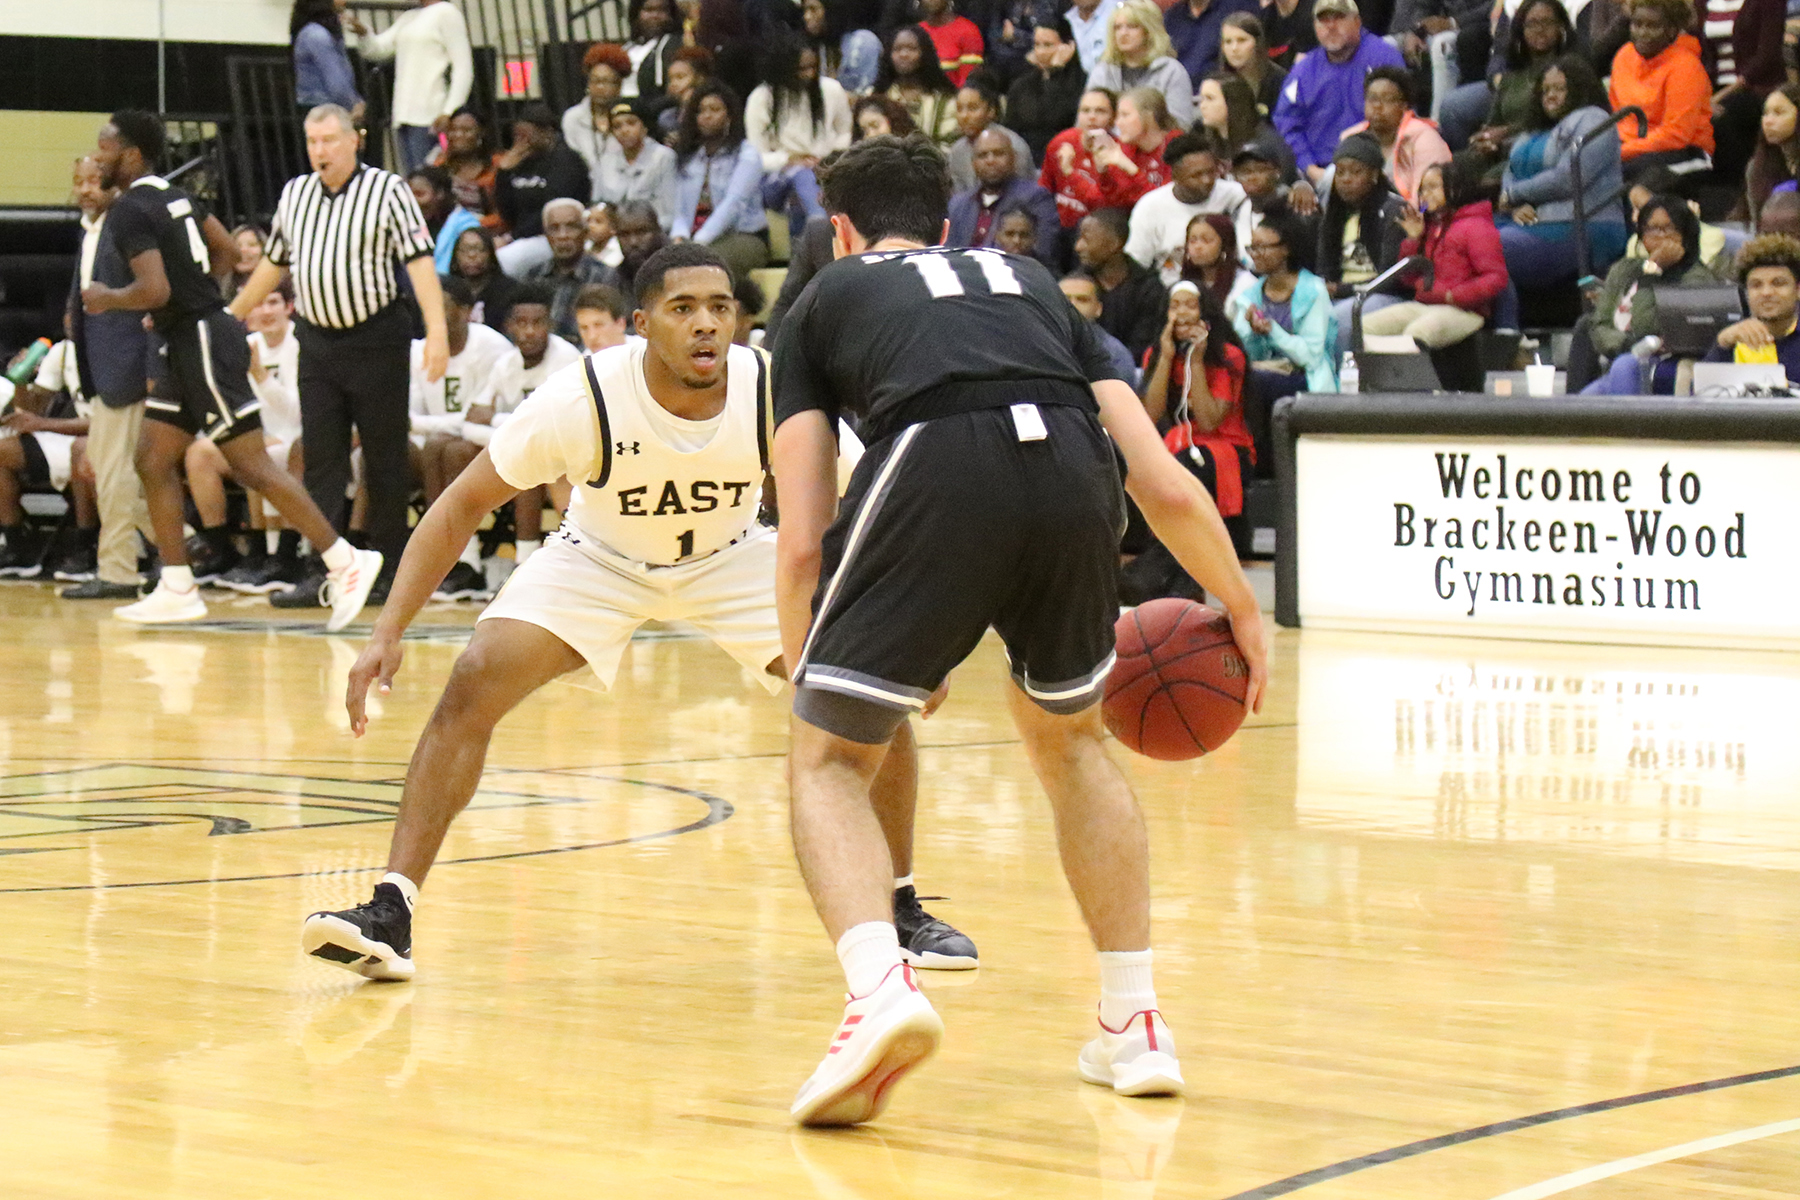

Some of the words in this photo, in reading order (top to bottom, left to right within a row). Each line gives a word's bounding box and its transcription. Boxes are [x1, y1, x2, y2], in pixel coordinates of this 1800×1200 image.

[184, 216, 211, 274] 4
[901, 248, 1023, 299] 11
[617, 480, 752, 516] EAST
[1434, 453, 1632, 503] Welcome
[1659, 463, 1701, 505] to
[674, 528, 695, 562] 1
[1393, 503, 1747, 559] Brackeen-Wood
[1434, 555, 1701, 616] Gymnasium
